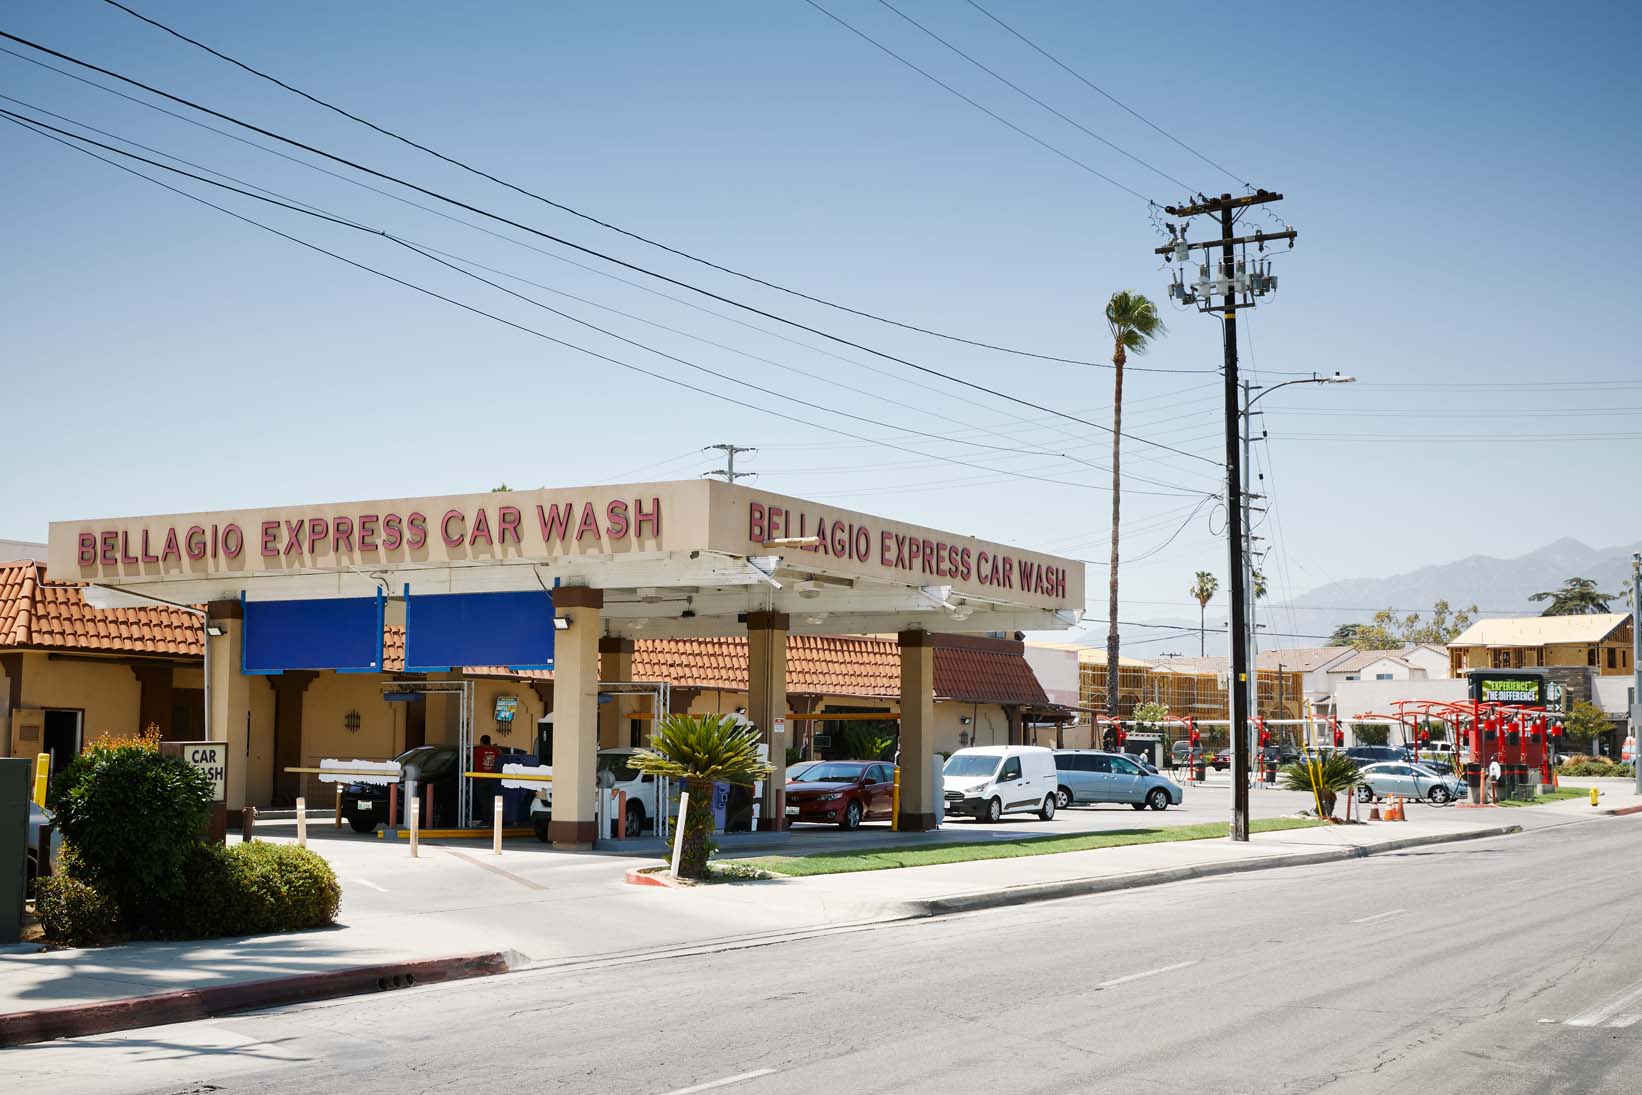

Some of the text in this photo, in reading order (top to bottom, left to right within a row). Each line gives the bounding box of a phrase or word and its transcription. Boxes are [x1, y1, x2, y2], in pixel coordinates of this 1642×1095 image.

[78, 497, 659, 566] BELLAGIO EXPRESS CAR WASH
[750, 502, 1067, 599] BELLAGIO EXPRESS CAR WASH
[1491, 681, 1529, 691] EXPERIENCE
[1487, 691, 1536, 701] THE DIFFERENCE
[192, 750, 216, 763] CAR
[201, 767, 223, 780] SH
